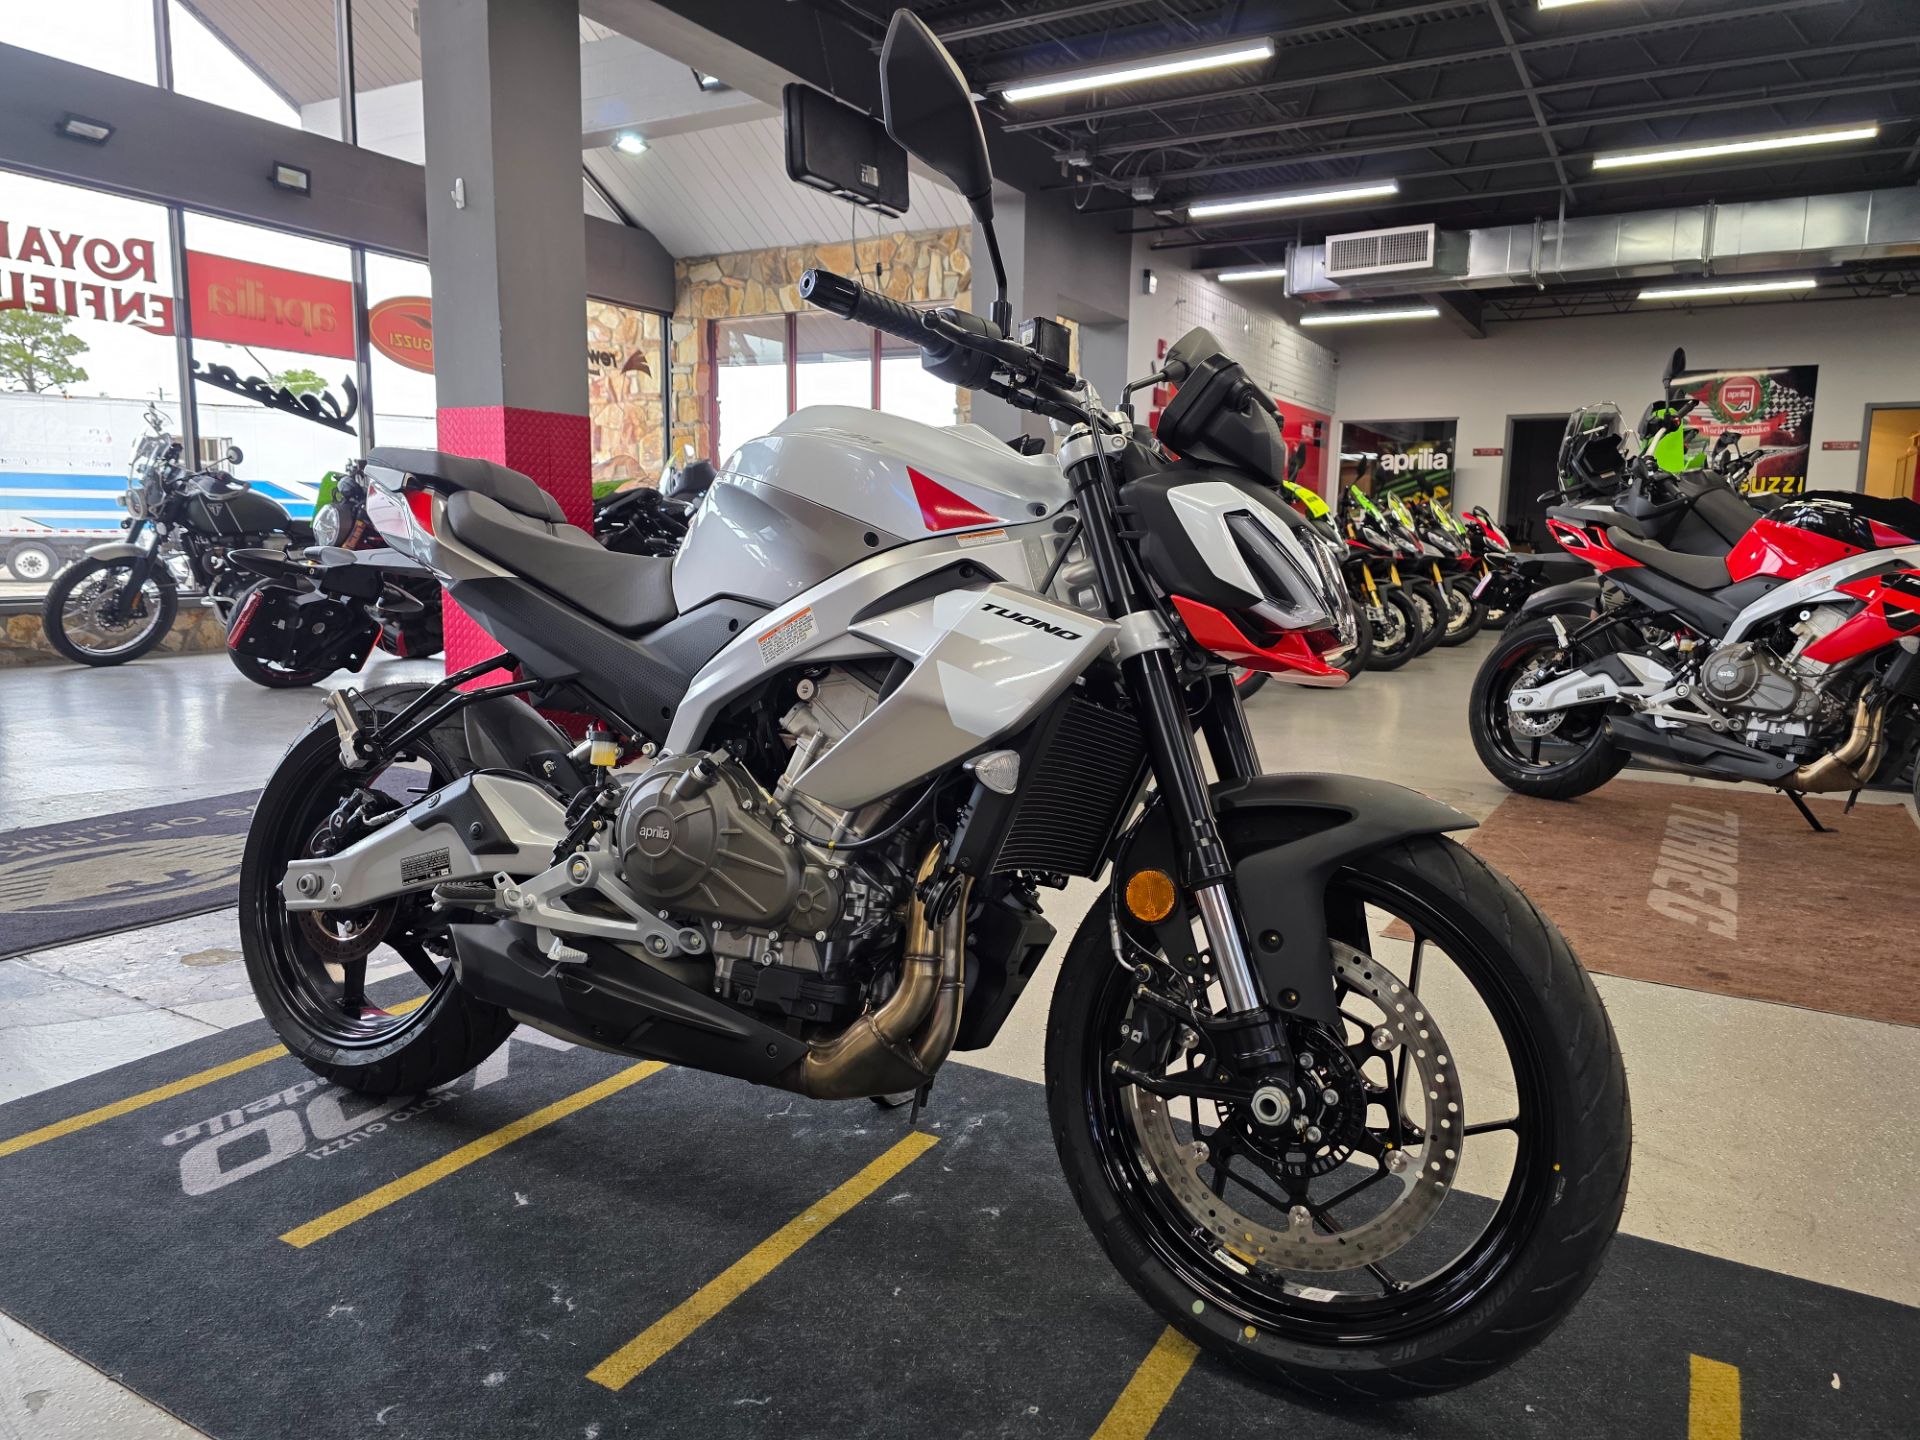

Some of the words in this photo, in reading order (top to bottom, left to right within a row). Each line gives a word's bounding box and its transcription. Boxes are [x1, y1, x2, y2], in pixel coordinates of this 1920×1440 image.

[1381, 447, 1448, 474] aprilia
[981, 603, 1082, 640] TUONO
[639, 825, 670, 840] aprilia
[161, 1075, 331, 1147] dello
[305, 1121, 387, 1161] GUZZI
